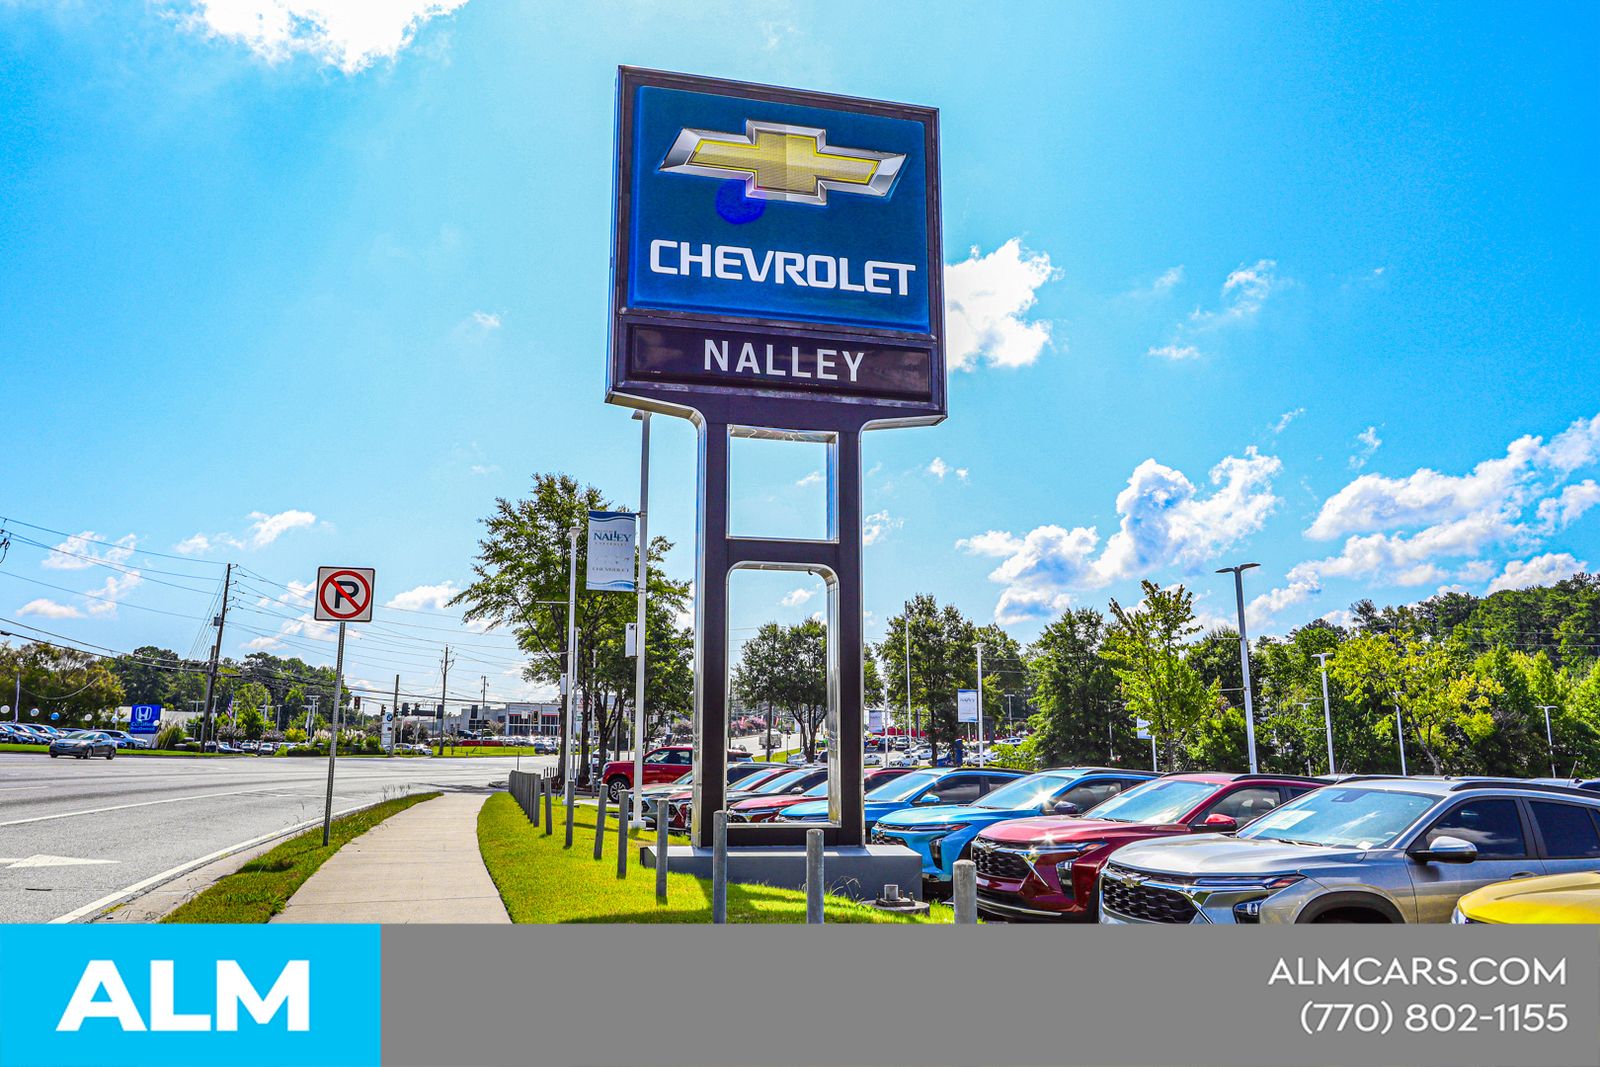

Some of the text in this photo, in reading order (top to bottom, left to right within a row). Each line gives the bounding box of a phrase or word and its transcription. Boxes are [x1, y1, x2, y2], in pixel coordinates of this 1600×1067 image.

[650, 239, 916, 296] CHEVROLET
[704, 339, 864, 382] NALLEY
[334, 580, 359, 609] P
